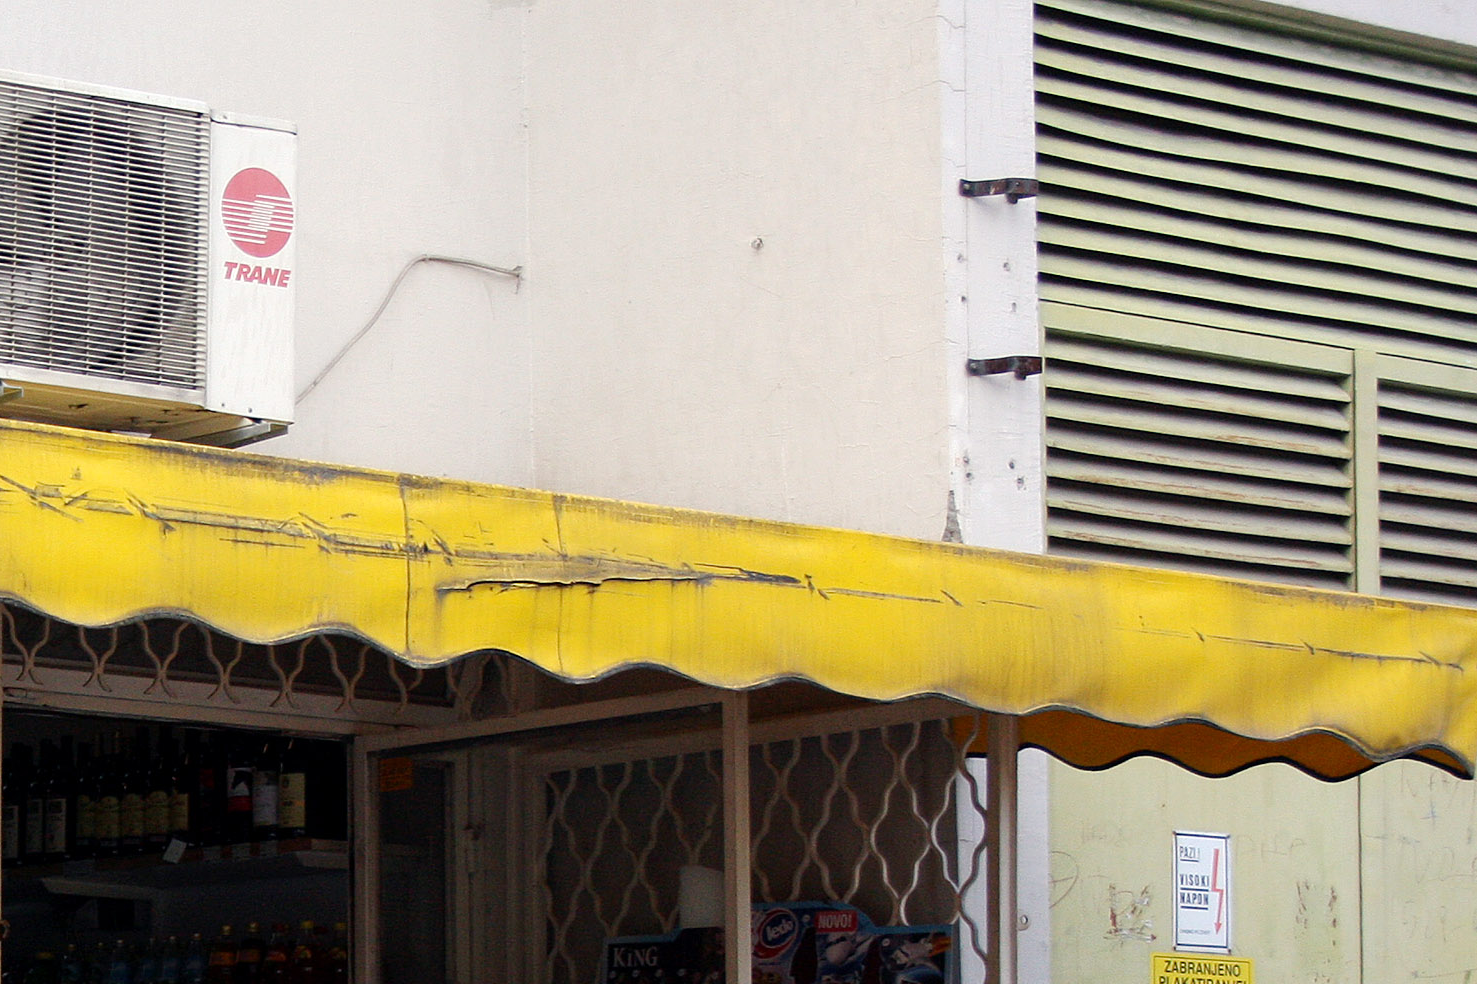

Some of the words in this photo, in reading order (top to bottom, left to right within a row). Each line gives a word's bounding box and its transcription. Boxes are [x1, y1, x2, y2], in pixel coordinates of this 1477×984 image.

[224, 261, 292, 288] TRANE
[1179, 873, 1210, 887] VISOKI
[1179, 892, 1209, 906] NAPON
[817, 912, 853, 929] NOVO!
[1164, 960, 1241, 977] ZABRANJENO
